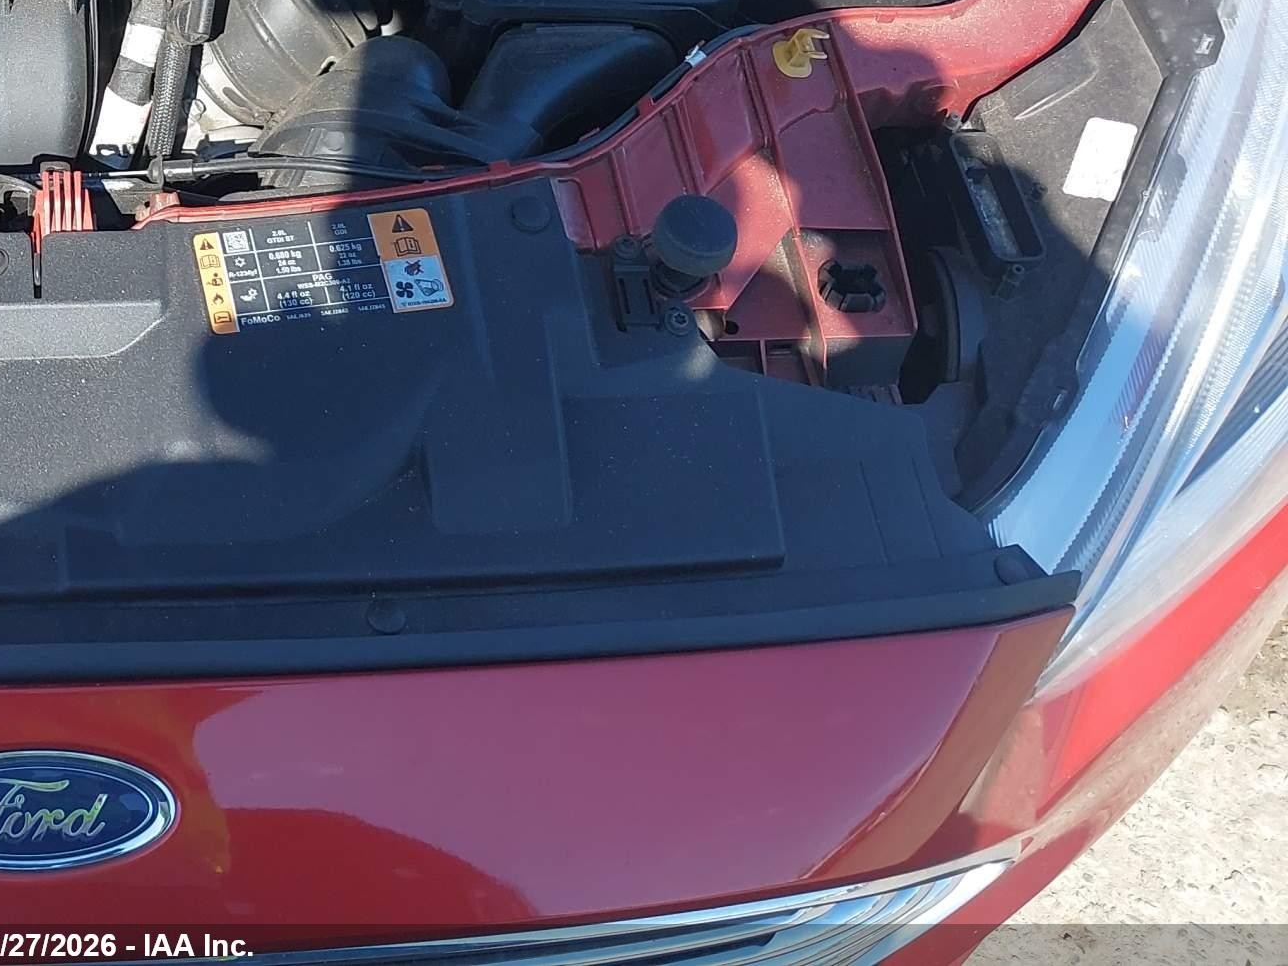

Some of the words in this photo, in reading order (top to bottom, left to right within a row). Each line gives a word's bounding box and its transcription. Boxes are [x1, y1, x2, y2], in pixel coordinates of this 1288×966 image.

[329, 244, 350, 252] 0.625
[351, 242, 362, 251] kg
[290, 250, 302, 258] kg
[312, 273, 333, 282] PAG
[277, 292, 290, 300] 4.4
[342, 292, 361, 301] (120
[362, 290, 376, 298] cc)
[279, 299, 298, 308] (130
[300, 298, 313, 306] cc)
[241, 314, 281, 326] FoMoCo
